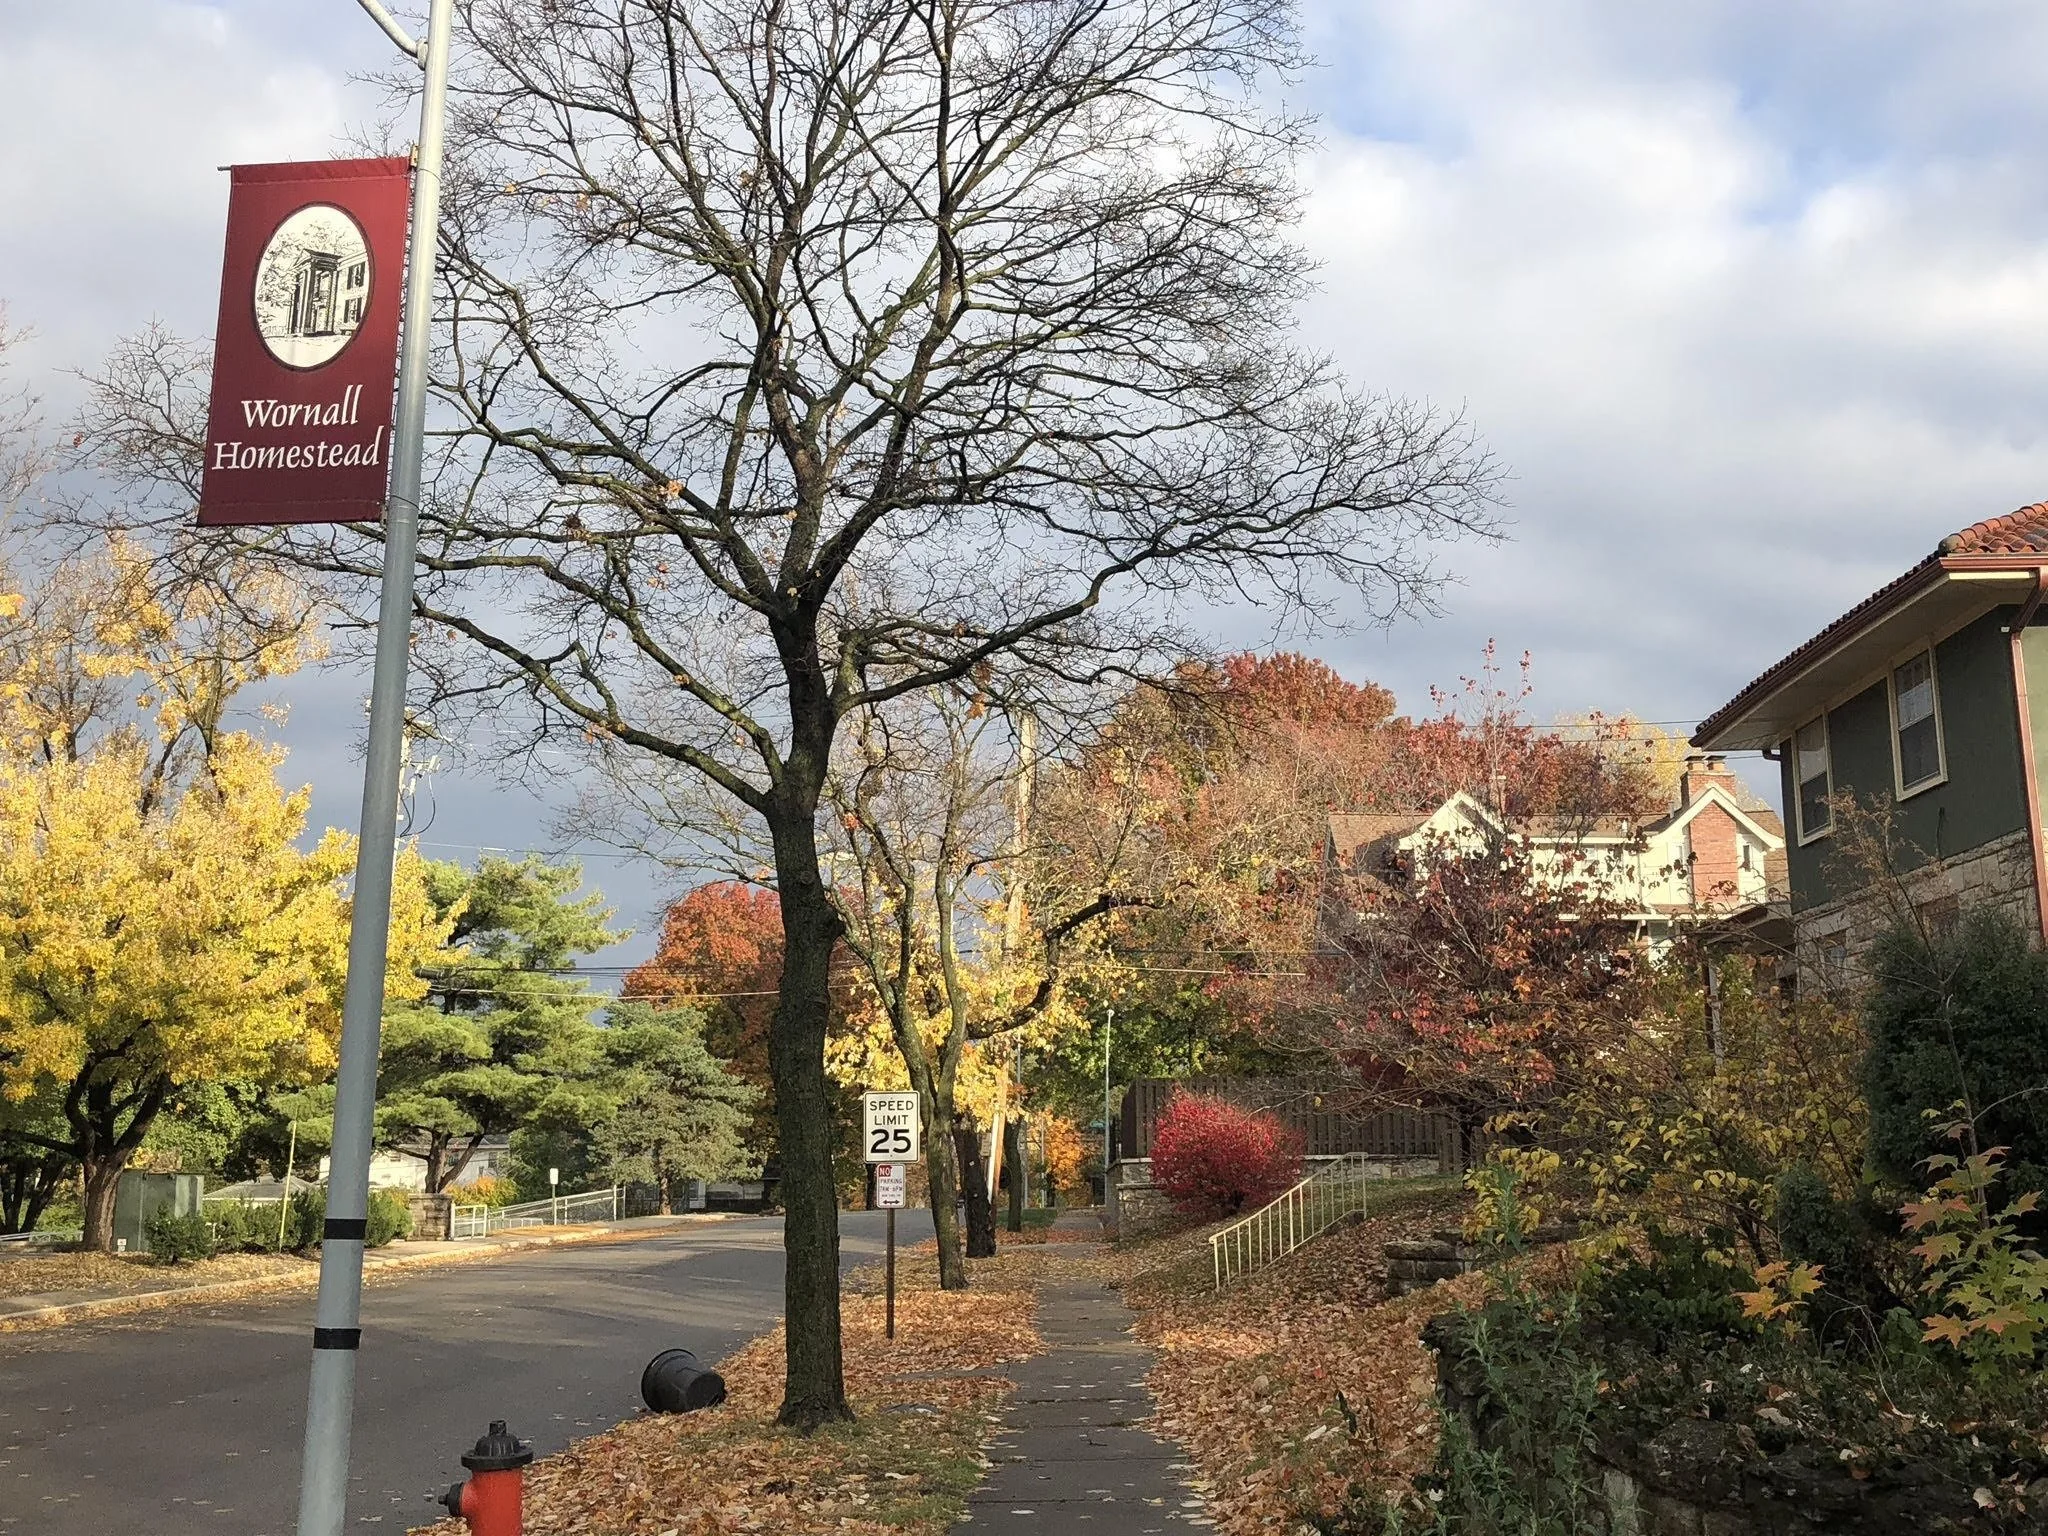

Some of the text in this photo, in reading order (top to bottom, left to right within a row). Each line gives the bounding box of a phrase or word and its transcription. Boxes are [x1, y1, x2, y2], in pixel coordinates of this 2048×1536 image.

[241, 384, 363, 427] Wornall
[211, 425, 384, 470] Homestead
[869, 1100, 914, 1111] SPEED
[874, 1115, 909, 1126] LIMIT
[870, 1129, 912, 1153] 25
[879, 1167, 891, 1176] NO
